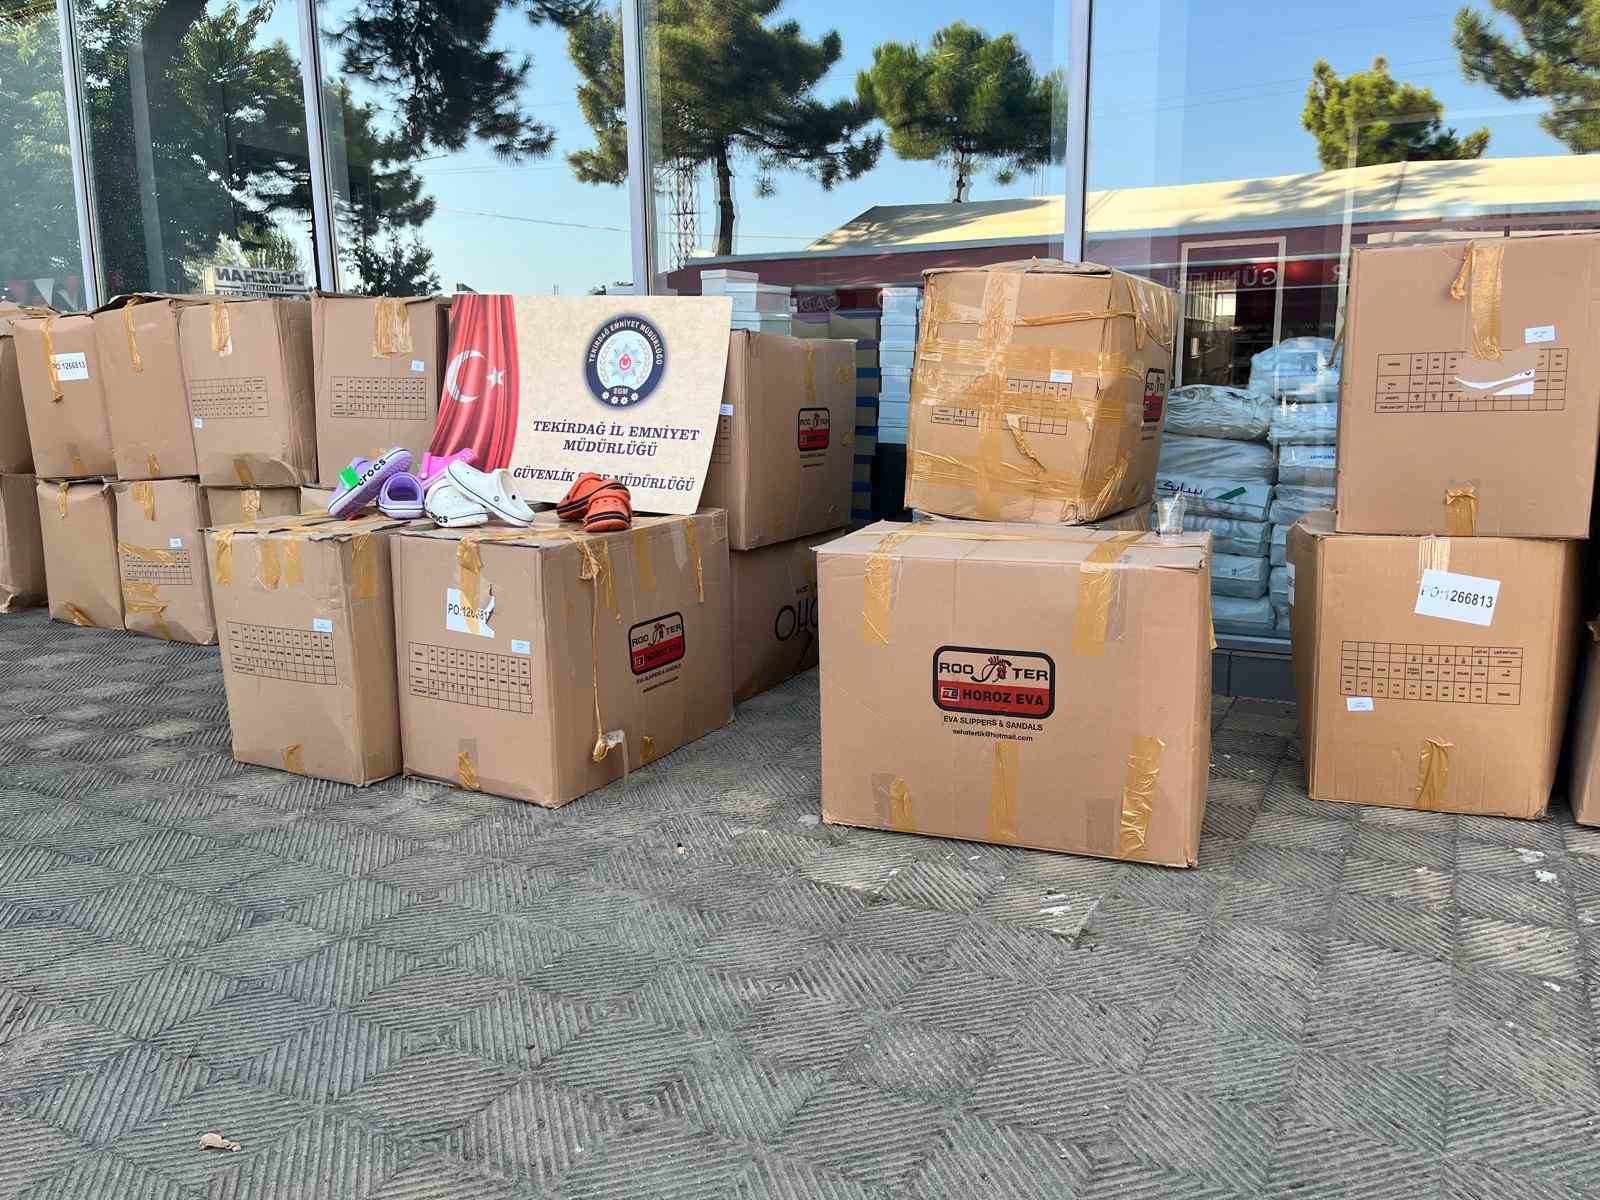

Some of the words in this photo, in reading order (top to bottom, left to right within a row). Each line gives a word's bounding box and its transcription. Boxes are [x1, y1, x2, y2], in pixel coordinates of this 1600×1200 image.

[533, 418, 606, 436] TEKİRDAĞ
[609, 421, 625, 437] İL
[628, 424, 700, 441] EMNİYET
[562, 437, 658, 457] MÜDÜRLÜĞÜ
[357, 458, 387, 486] crocs
[513, 465, 576, 482] GÜVENLİK
[962, 688, 1012, 704] HOROZ
[1015, 693, 1045, 706] EVA
[943, 715, 959, 724] EVA
[959, 716, 998, 727] SLIPPERS
[998, 720, 1004, 728] &
[1005, 721, 1044, 731] SANDALS
